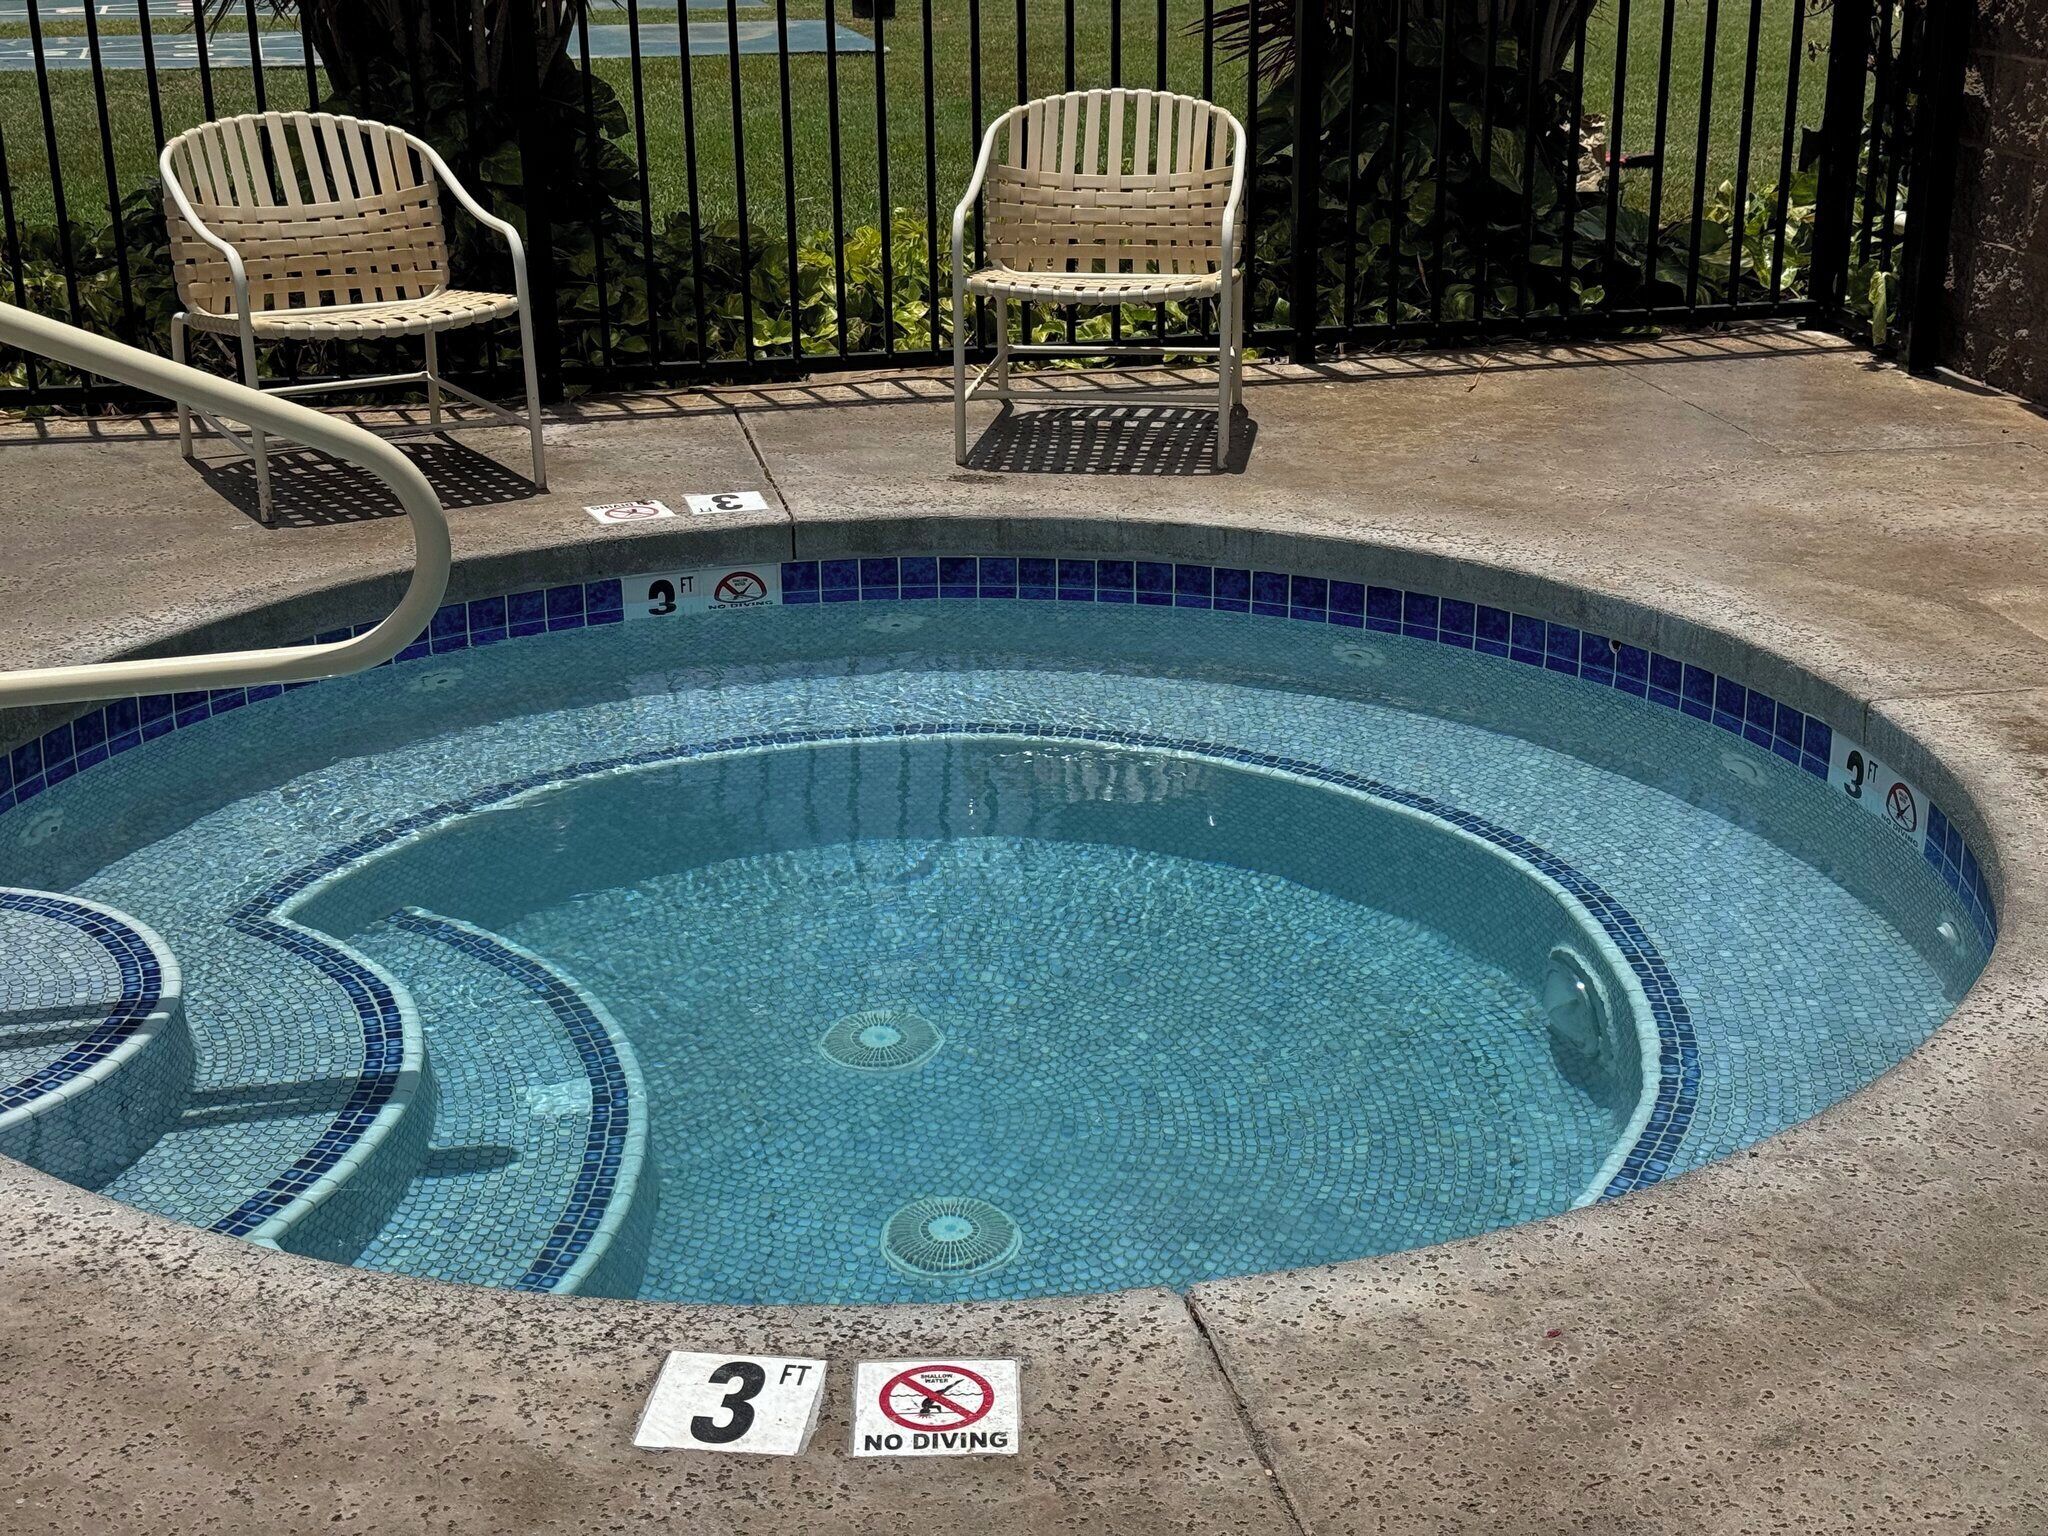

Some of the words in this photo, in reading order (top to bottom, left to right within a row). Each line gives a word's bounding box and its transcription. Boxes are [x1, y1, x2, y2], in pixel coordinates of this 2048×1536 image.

[712, 494, 743, 511] 3
[648, 579, 677, 616] 3
[680, 576, 694, 594] FT
[731, 600, 773, 608] DIVING
[1844, 750, 1865, 799] 3
[1867, 760, 1879, 783] FT
[690, 1361, 766, 1444] 3
[779, 1364, 812, 1386] FT
[864, 1434, 903, 1451] NO
[913, 1431, 1009, 1450] DIVING
